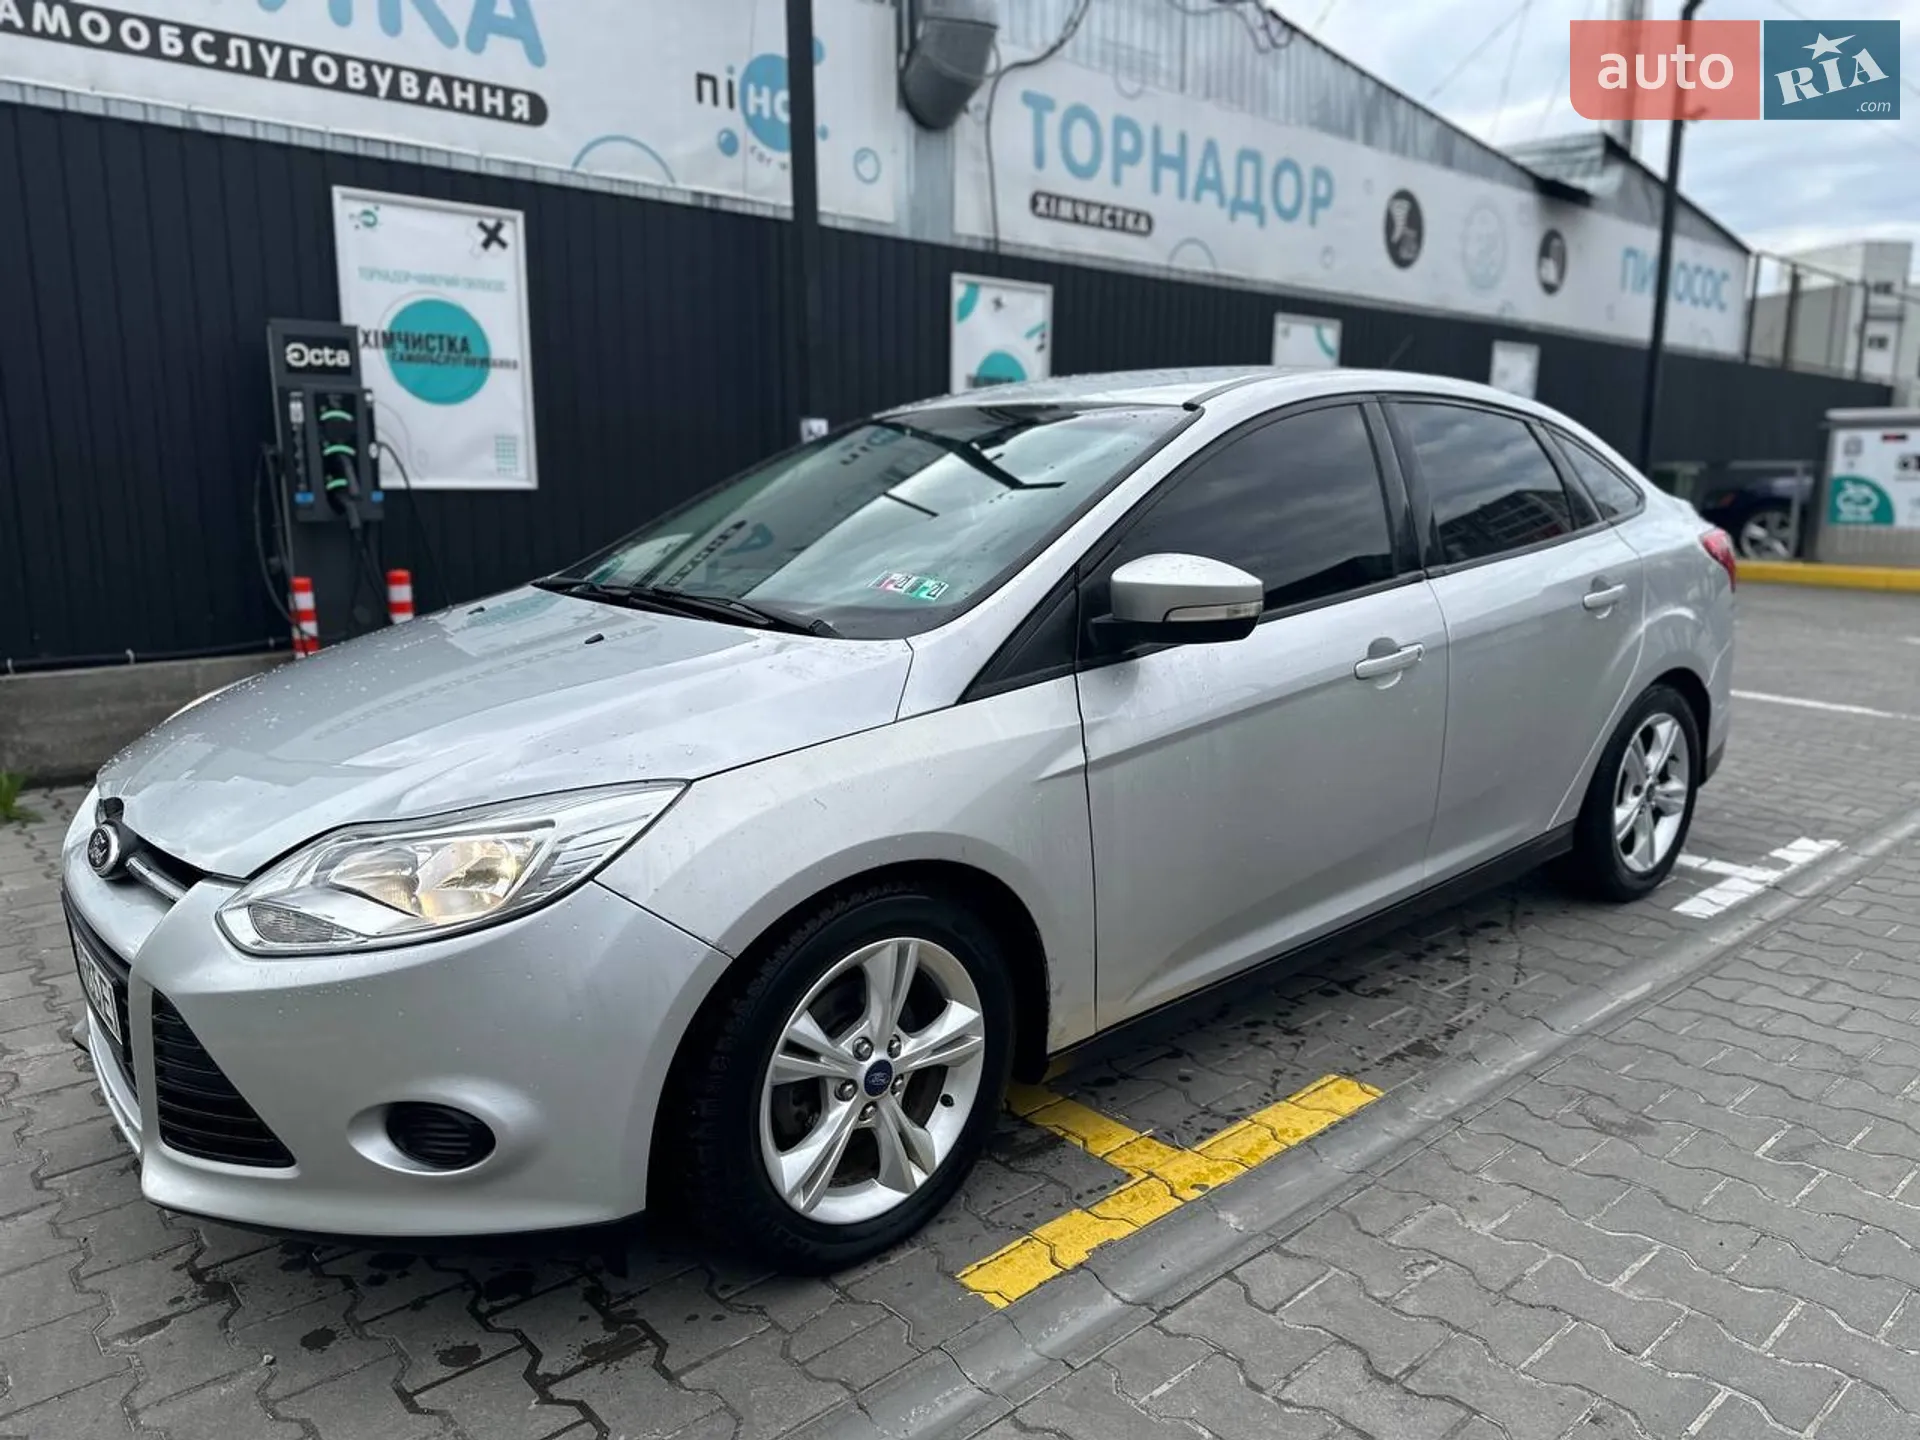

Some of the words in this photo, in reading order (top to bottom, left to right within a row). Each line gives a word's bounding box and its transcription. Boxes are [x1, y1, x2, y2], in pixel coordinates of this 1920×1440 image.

[1021, 89, 1335, 228] ТОРНАДОР
[1034, 195, 1149, 233] ХІМЧИСТКА
[1621, 248, 1730, 312] ПИОСОС
[361, 328, 472, 354] ХІМЧИСТКА
